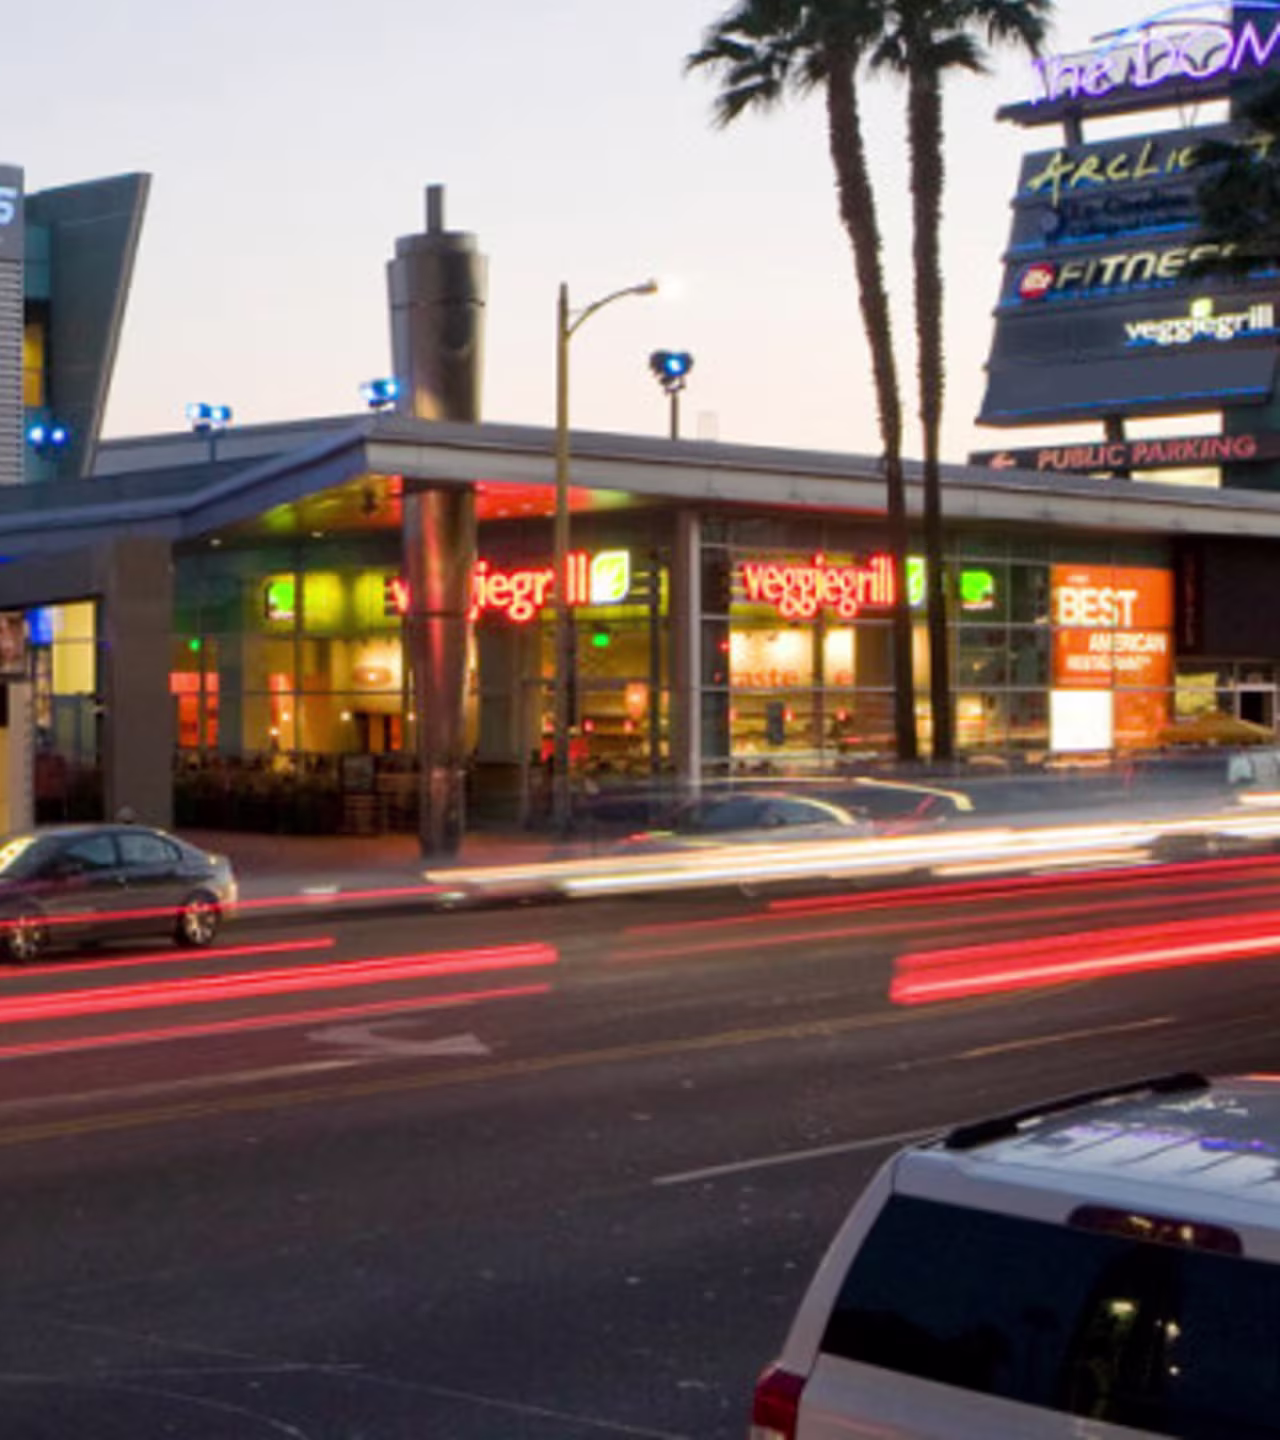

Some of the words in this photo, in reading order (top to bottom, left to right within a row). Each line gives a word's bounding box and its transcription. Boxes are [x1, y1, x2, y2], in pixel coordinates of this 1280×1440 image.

[1056, 243, 1237, 289] FITNE
[1123, 302, 1275, 344] veggiegrill
[1036, 444, 1125, 469] PUBLIC
[1131, 434, 1258, 464] PARKING
[743, 551, 895, 617] veggiegrill
[1057, 587, 1138, 628] BEST
